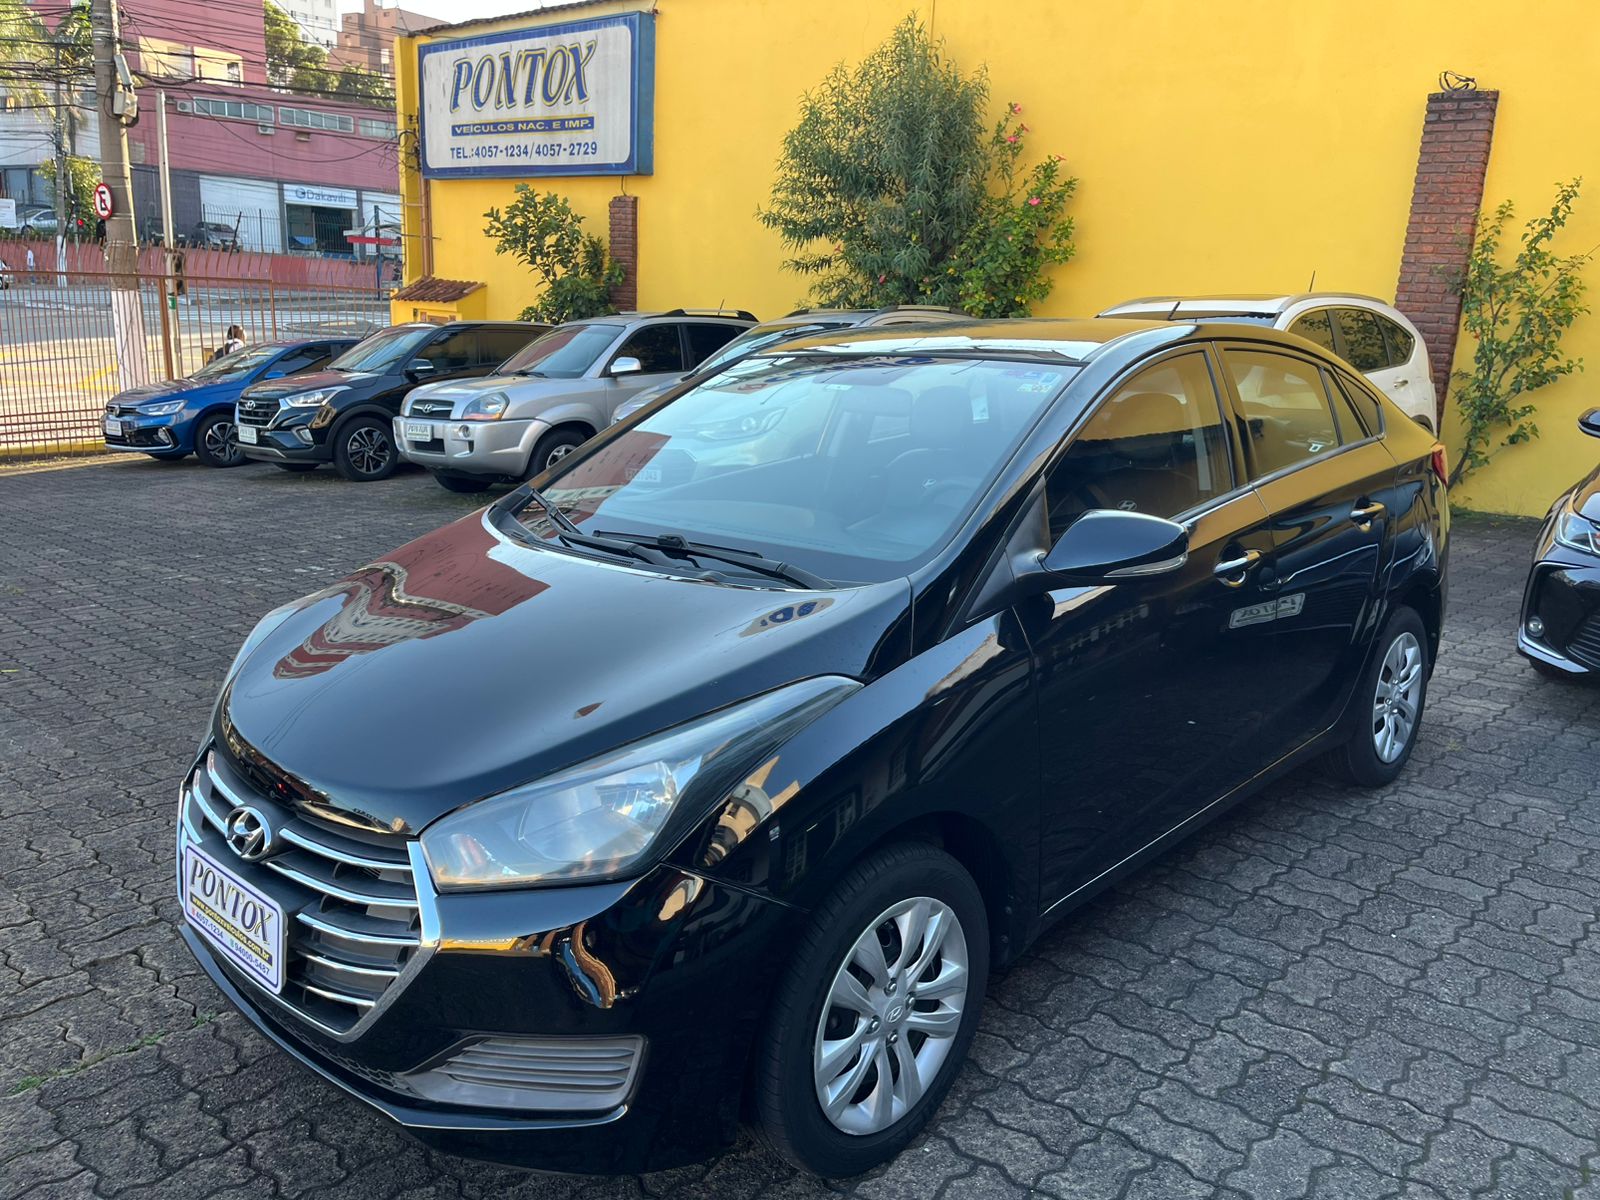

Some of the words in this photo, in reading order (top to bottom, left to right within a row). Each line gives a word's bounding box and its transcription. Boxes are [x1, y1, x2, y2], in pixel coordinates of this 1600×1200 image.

[450, 39, 597, 113] PONTOX
[518, 121, 549, 131] NAC.
[552, 120, 561, 129] E
[564, 118, 592, 128] IMP.
[190, 857, 273, 946] PONTOX
[191, 894, 270, 961] www.pontoxveiculos.com.br
